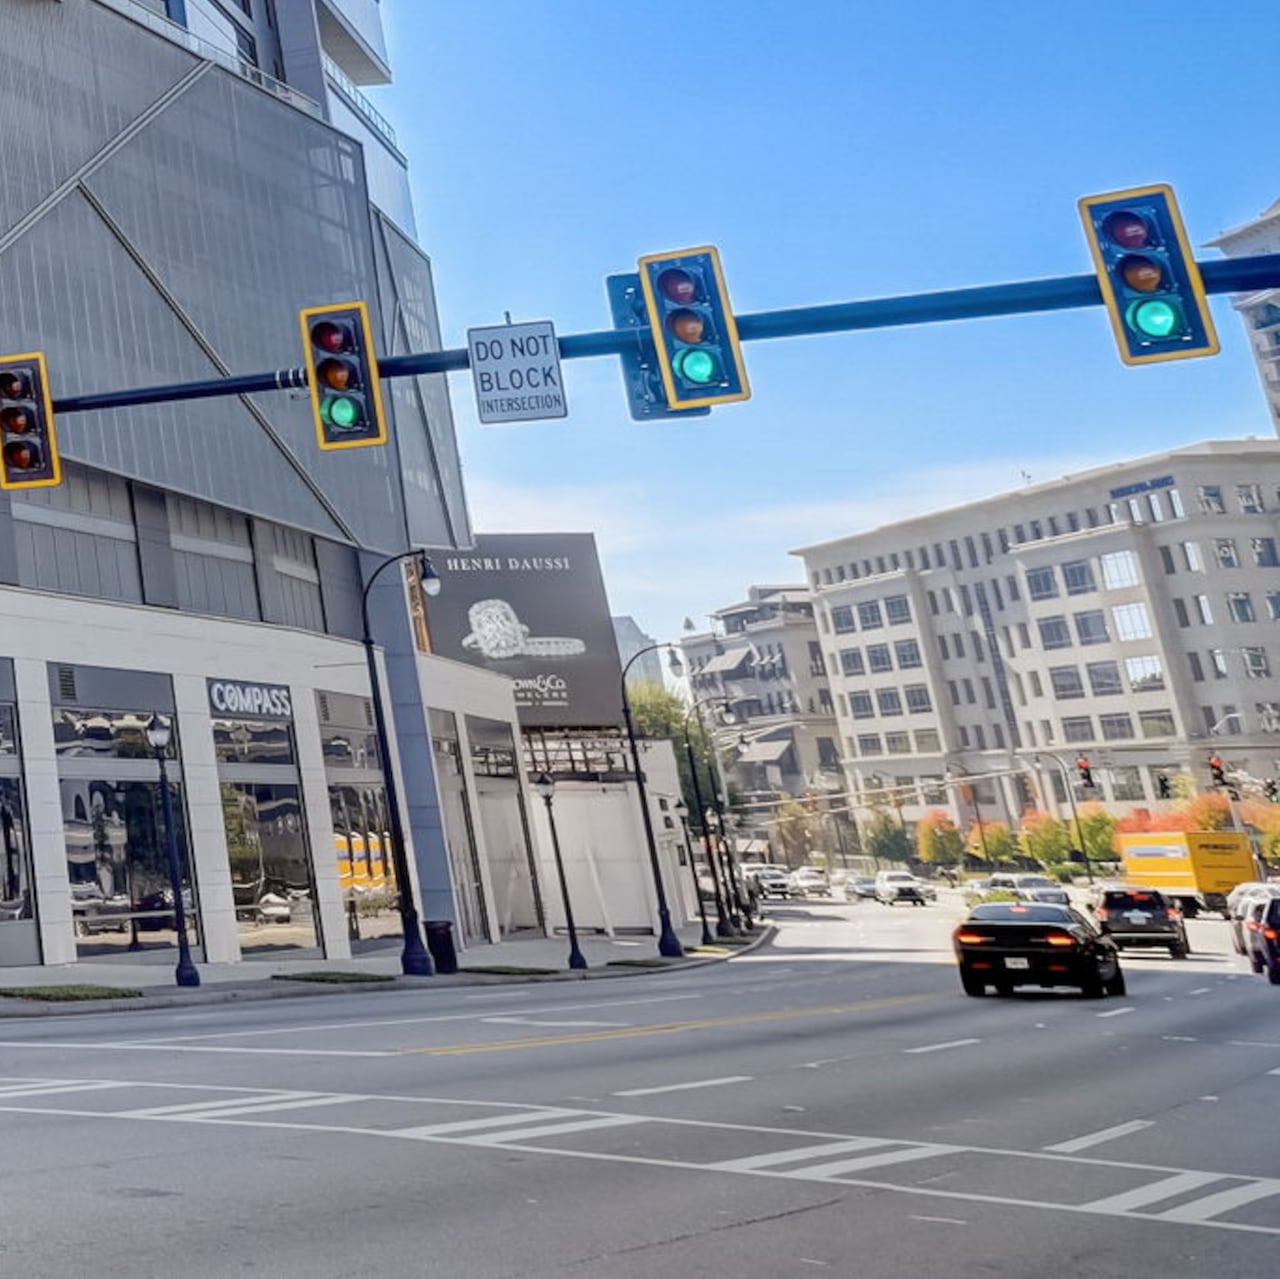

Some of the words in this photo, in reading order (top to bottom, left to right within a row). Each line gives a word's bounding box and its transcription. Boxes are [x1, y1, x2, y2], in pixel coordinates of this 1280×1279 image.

[475, 339, 504, 362] DO
[510, 334, 550, 358] NOT
[479, 366, 557, 392] BLOCK
[482, 393, 562, 414] INTERSECTION
[446, 557, 502, 571] HENRI
[508, 556, 571, 570] DAUSSI
[210, 682, 291, 716] COMPASS
